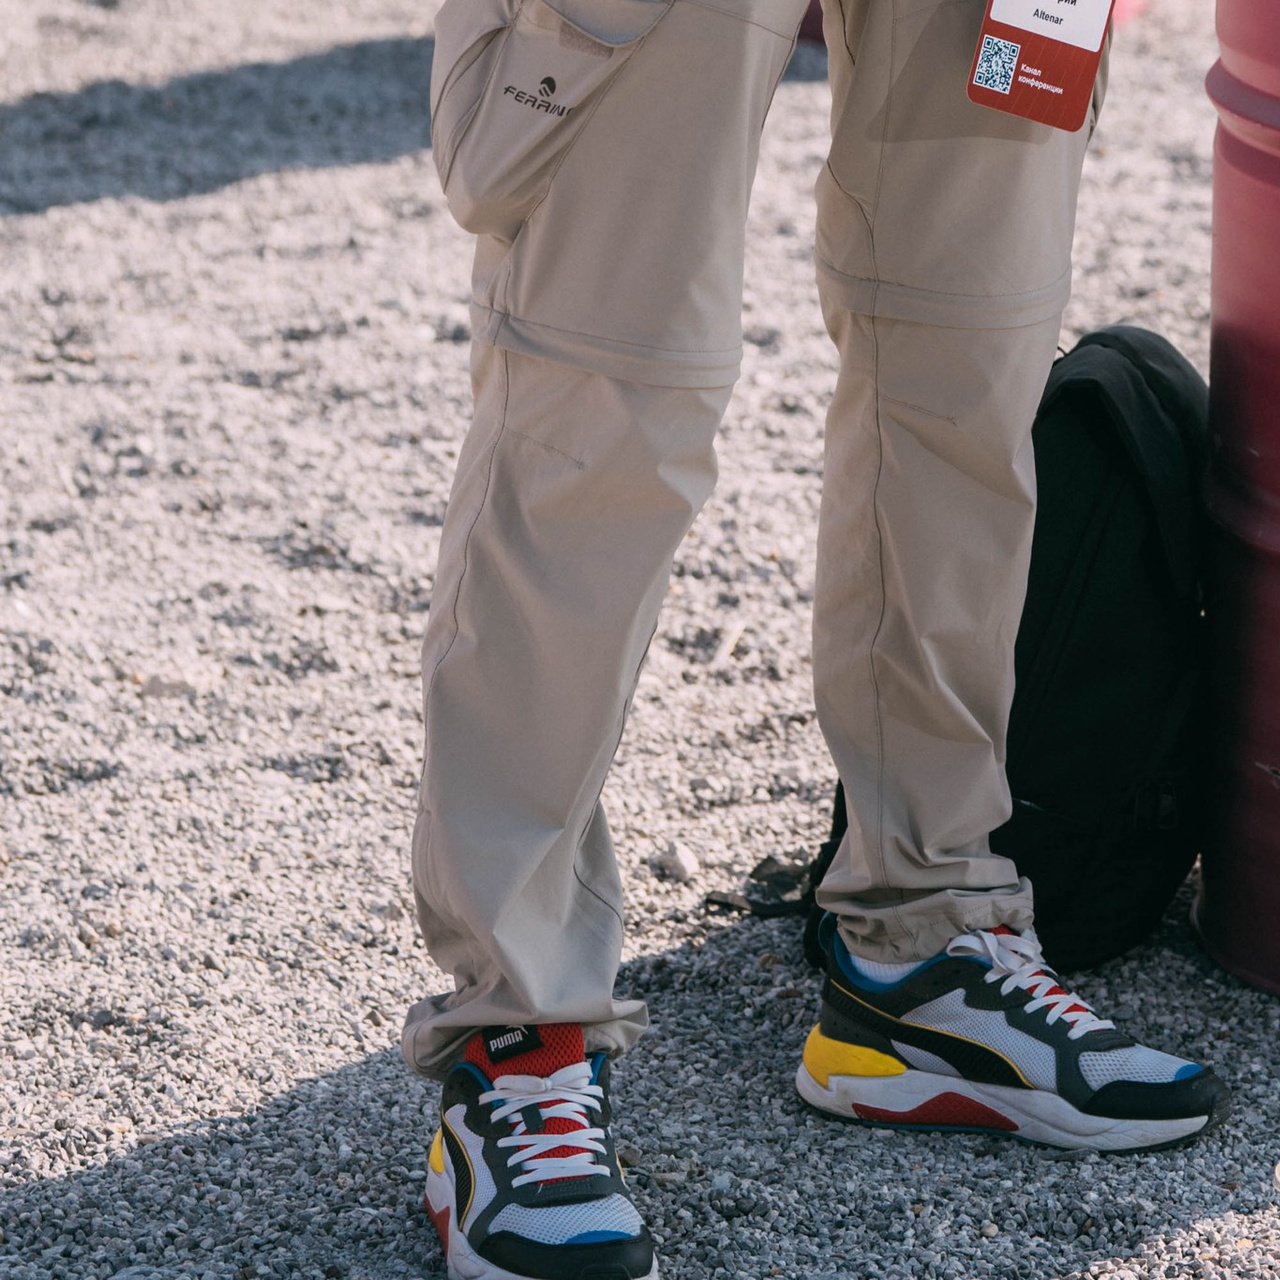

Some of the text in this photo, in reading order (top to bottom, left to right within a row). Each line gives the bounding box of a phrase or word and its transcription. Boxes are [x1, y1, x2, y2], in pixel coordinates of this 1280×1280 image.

[1033, 8, 1064, 25] Altenar
[1020, 63, 1042, 76] Канал
[1018, 75, 1063, 95] конференции
[489, 1030, 523, 1052] PUMA
